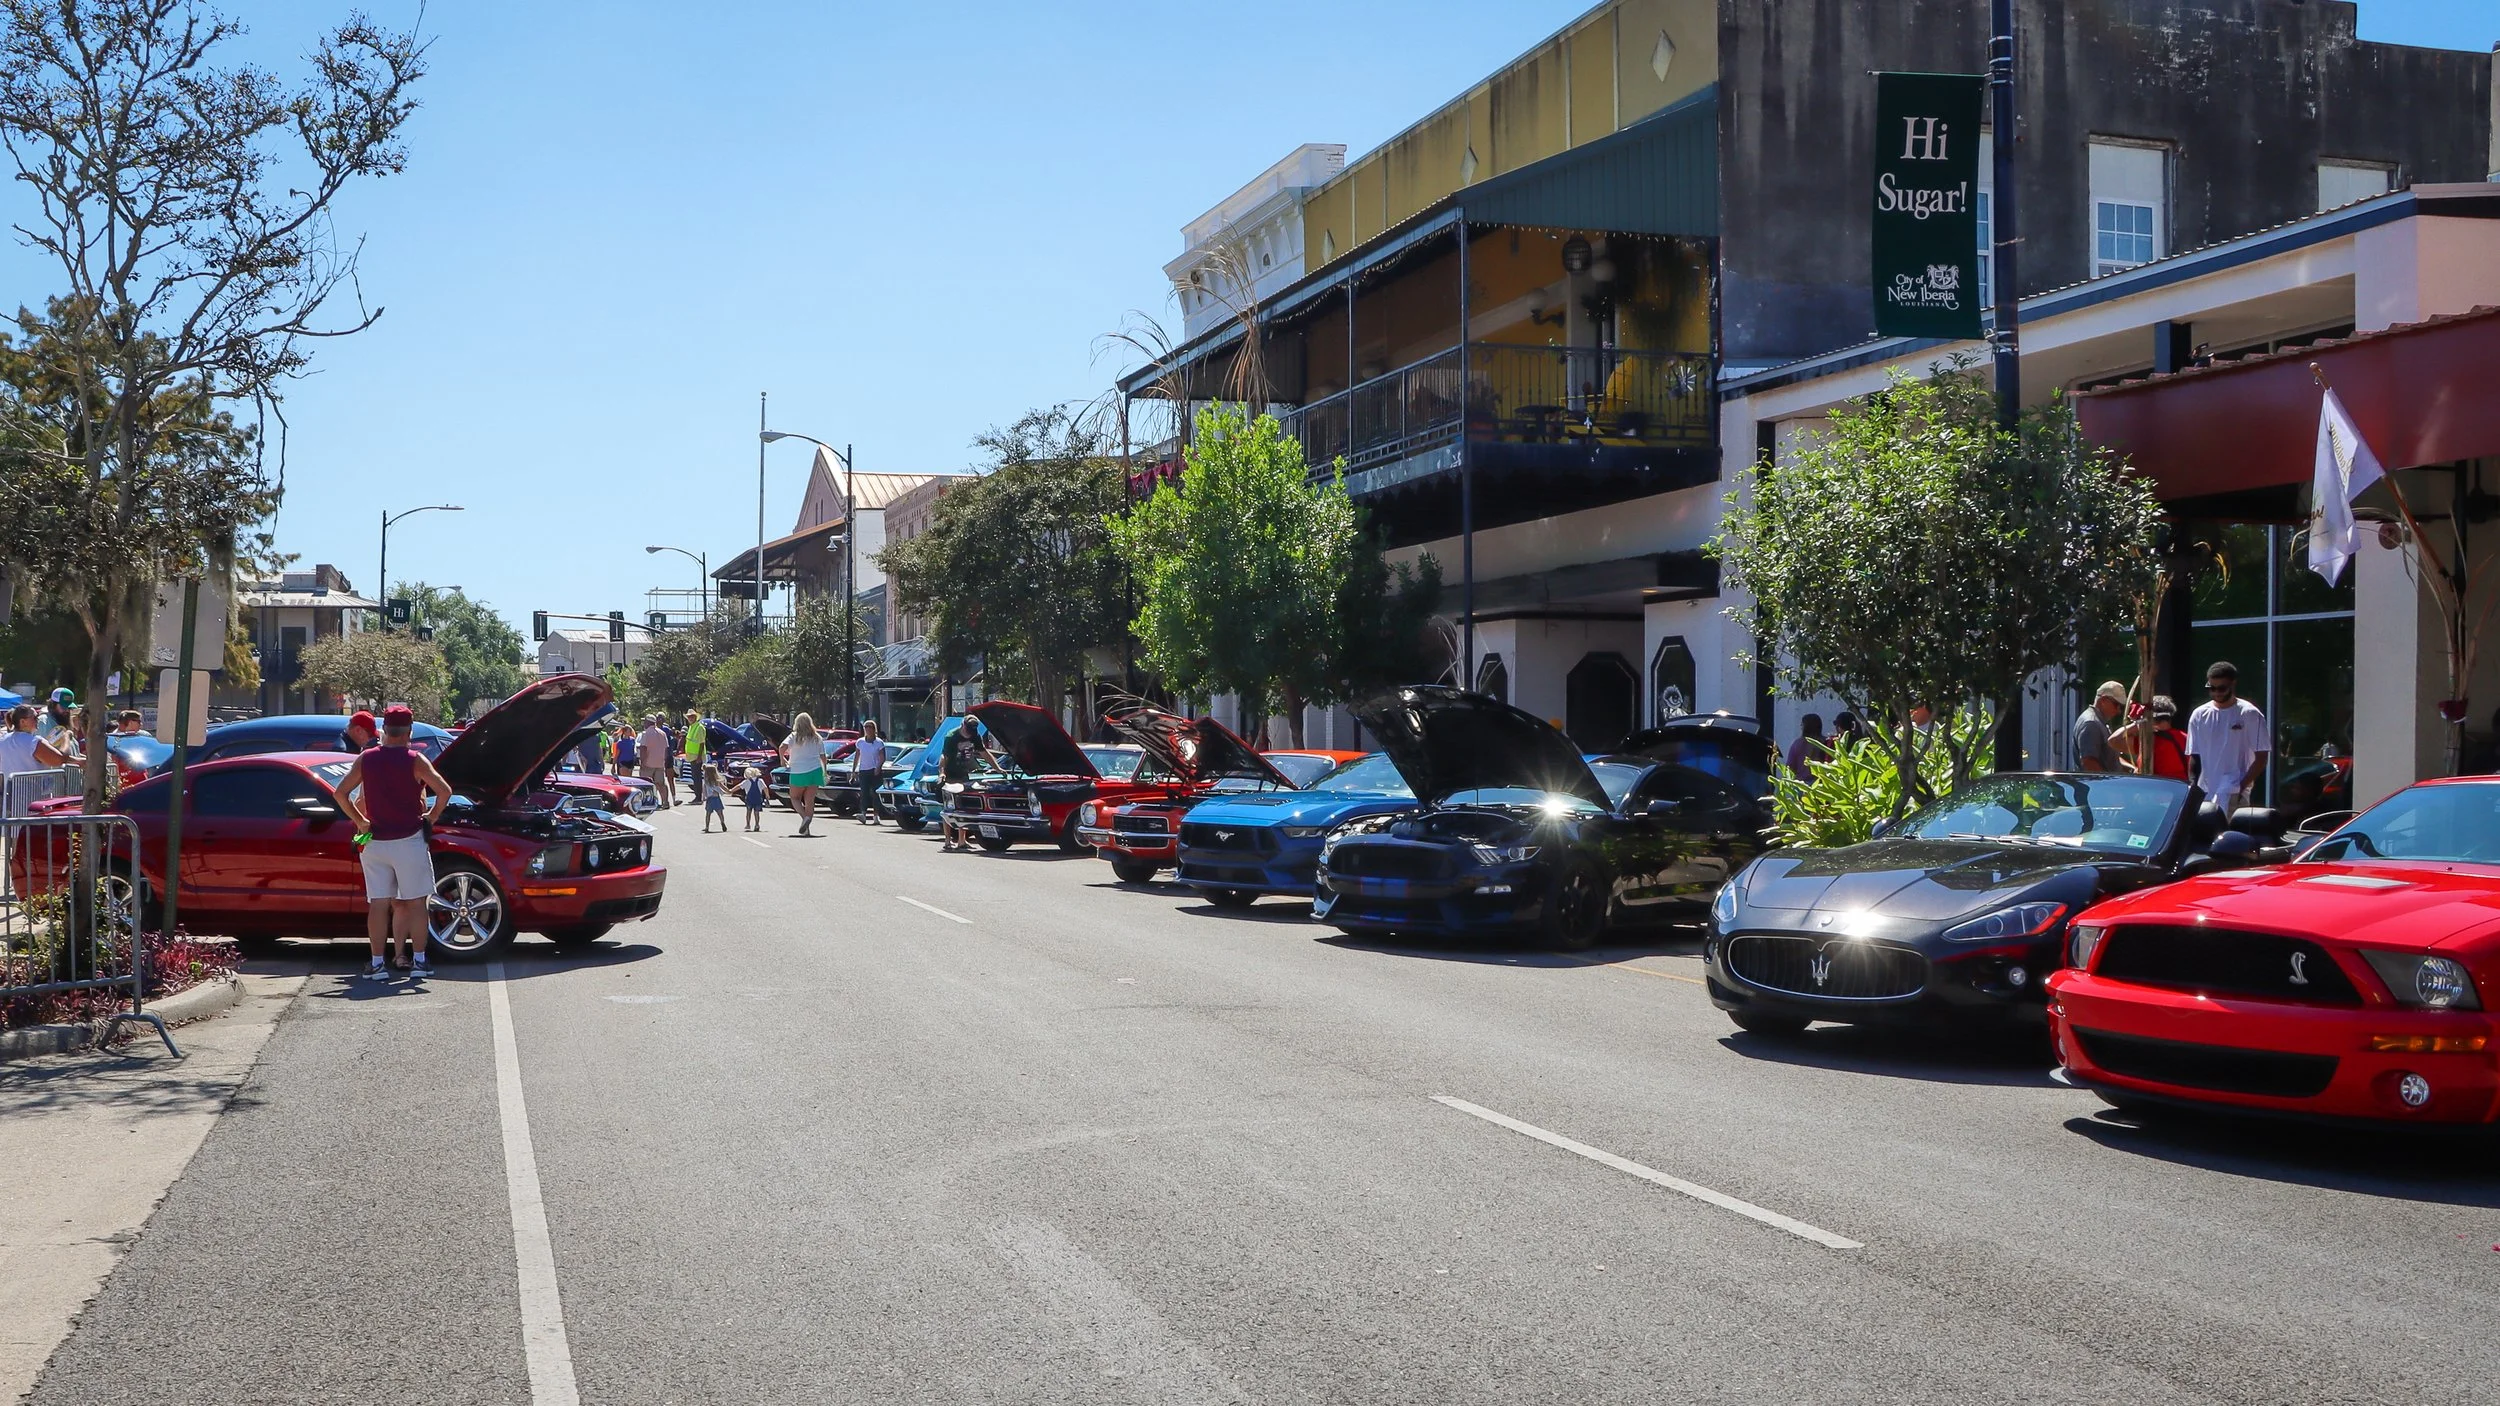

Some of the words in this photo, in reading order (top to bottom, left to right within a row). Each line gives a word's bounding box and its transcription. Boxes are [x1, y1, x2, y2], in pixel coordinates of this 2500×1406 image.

[1900, 116, 1948, 160] Hi
[1878, 173, 1967, 220] Sugar!
[1896, 274, 1913, 291] City
[1915, 275, 1924, 284] of
[1887, 287, 1917, 301] New
[1920, 284, 1959, 309] Iberia
[393, 607, 404, 618] Hi
